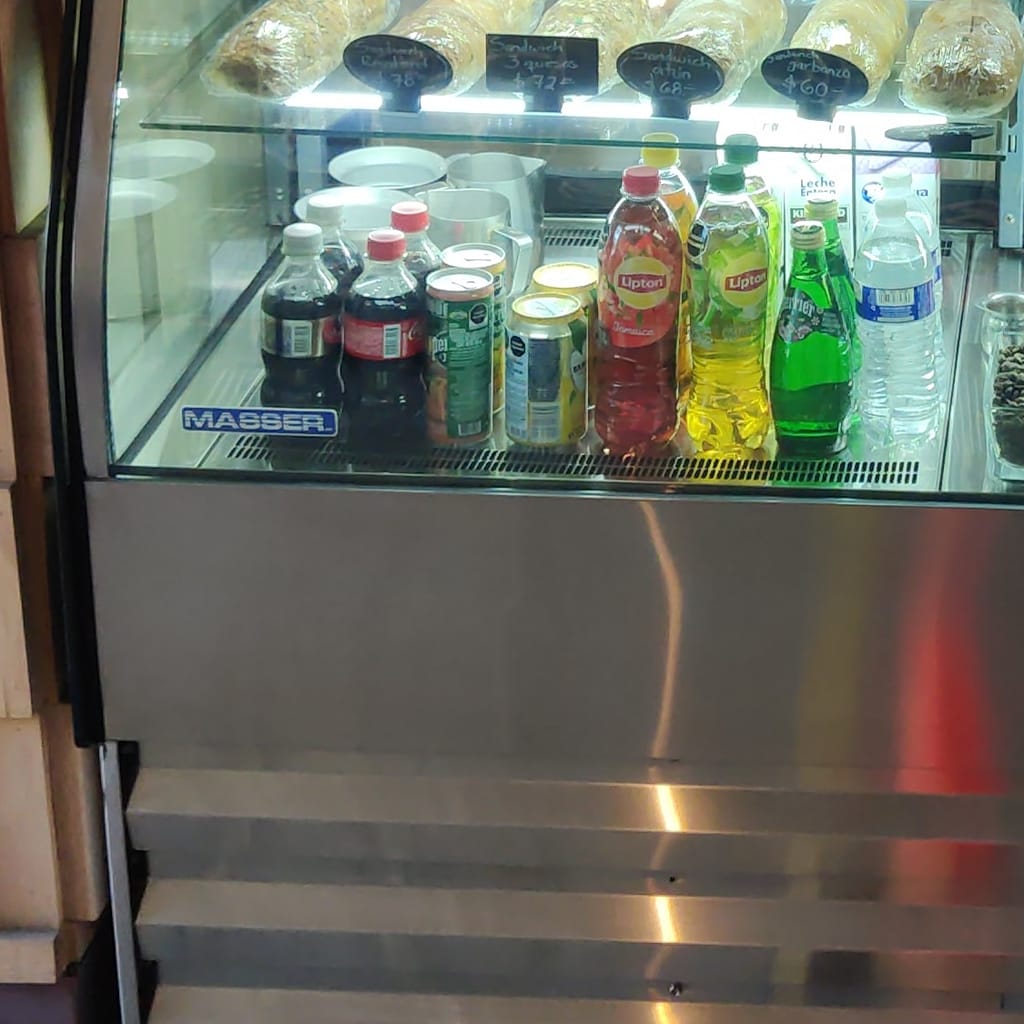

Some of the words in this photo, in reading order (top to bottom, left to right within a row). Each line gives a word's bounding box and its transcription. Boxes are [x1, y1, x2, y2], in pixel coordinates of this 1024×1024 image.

[504, 56, 519, 70] 3
[630, 47, 713, 69] Sandwich
[801, 176, 836, 189] Leche
[622, 276, 664, 290] Lipton
[184, 410, 325, 432] MASSER
